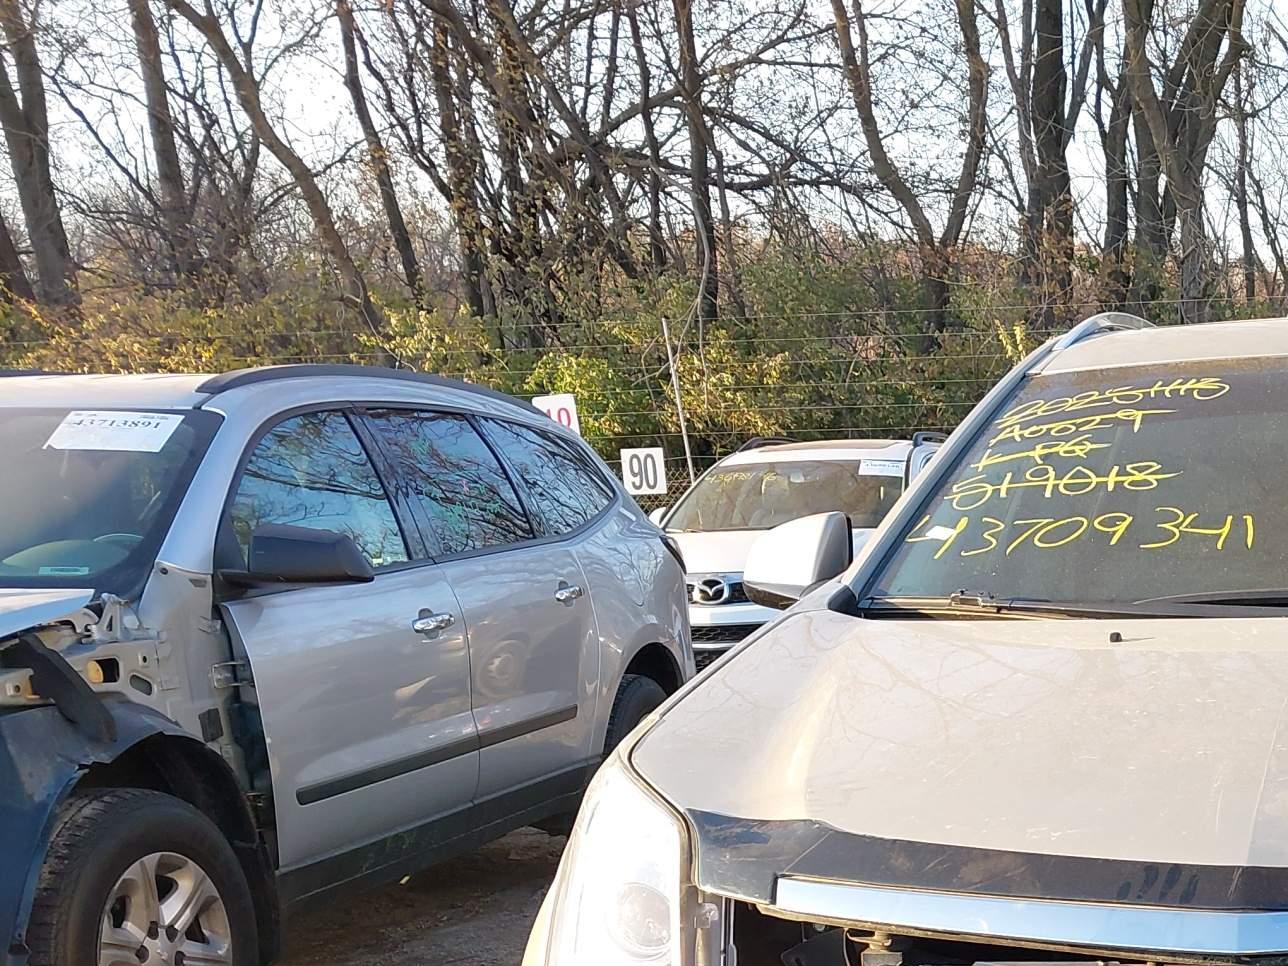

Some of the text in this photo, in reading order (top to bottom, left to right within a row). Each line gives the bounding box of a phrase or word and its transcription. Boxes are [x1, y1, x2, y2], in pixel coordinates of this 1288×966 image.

[629, 453, 658, 490] 90
[947, 462, 1168, 510] 519018
[906, 507, 1254, 560] 43709341
